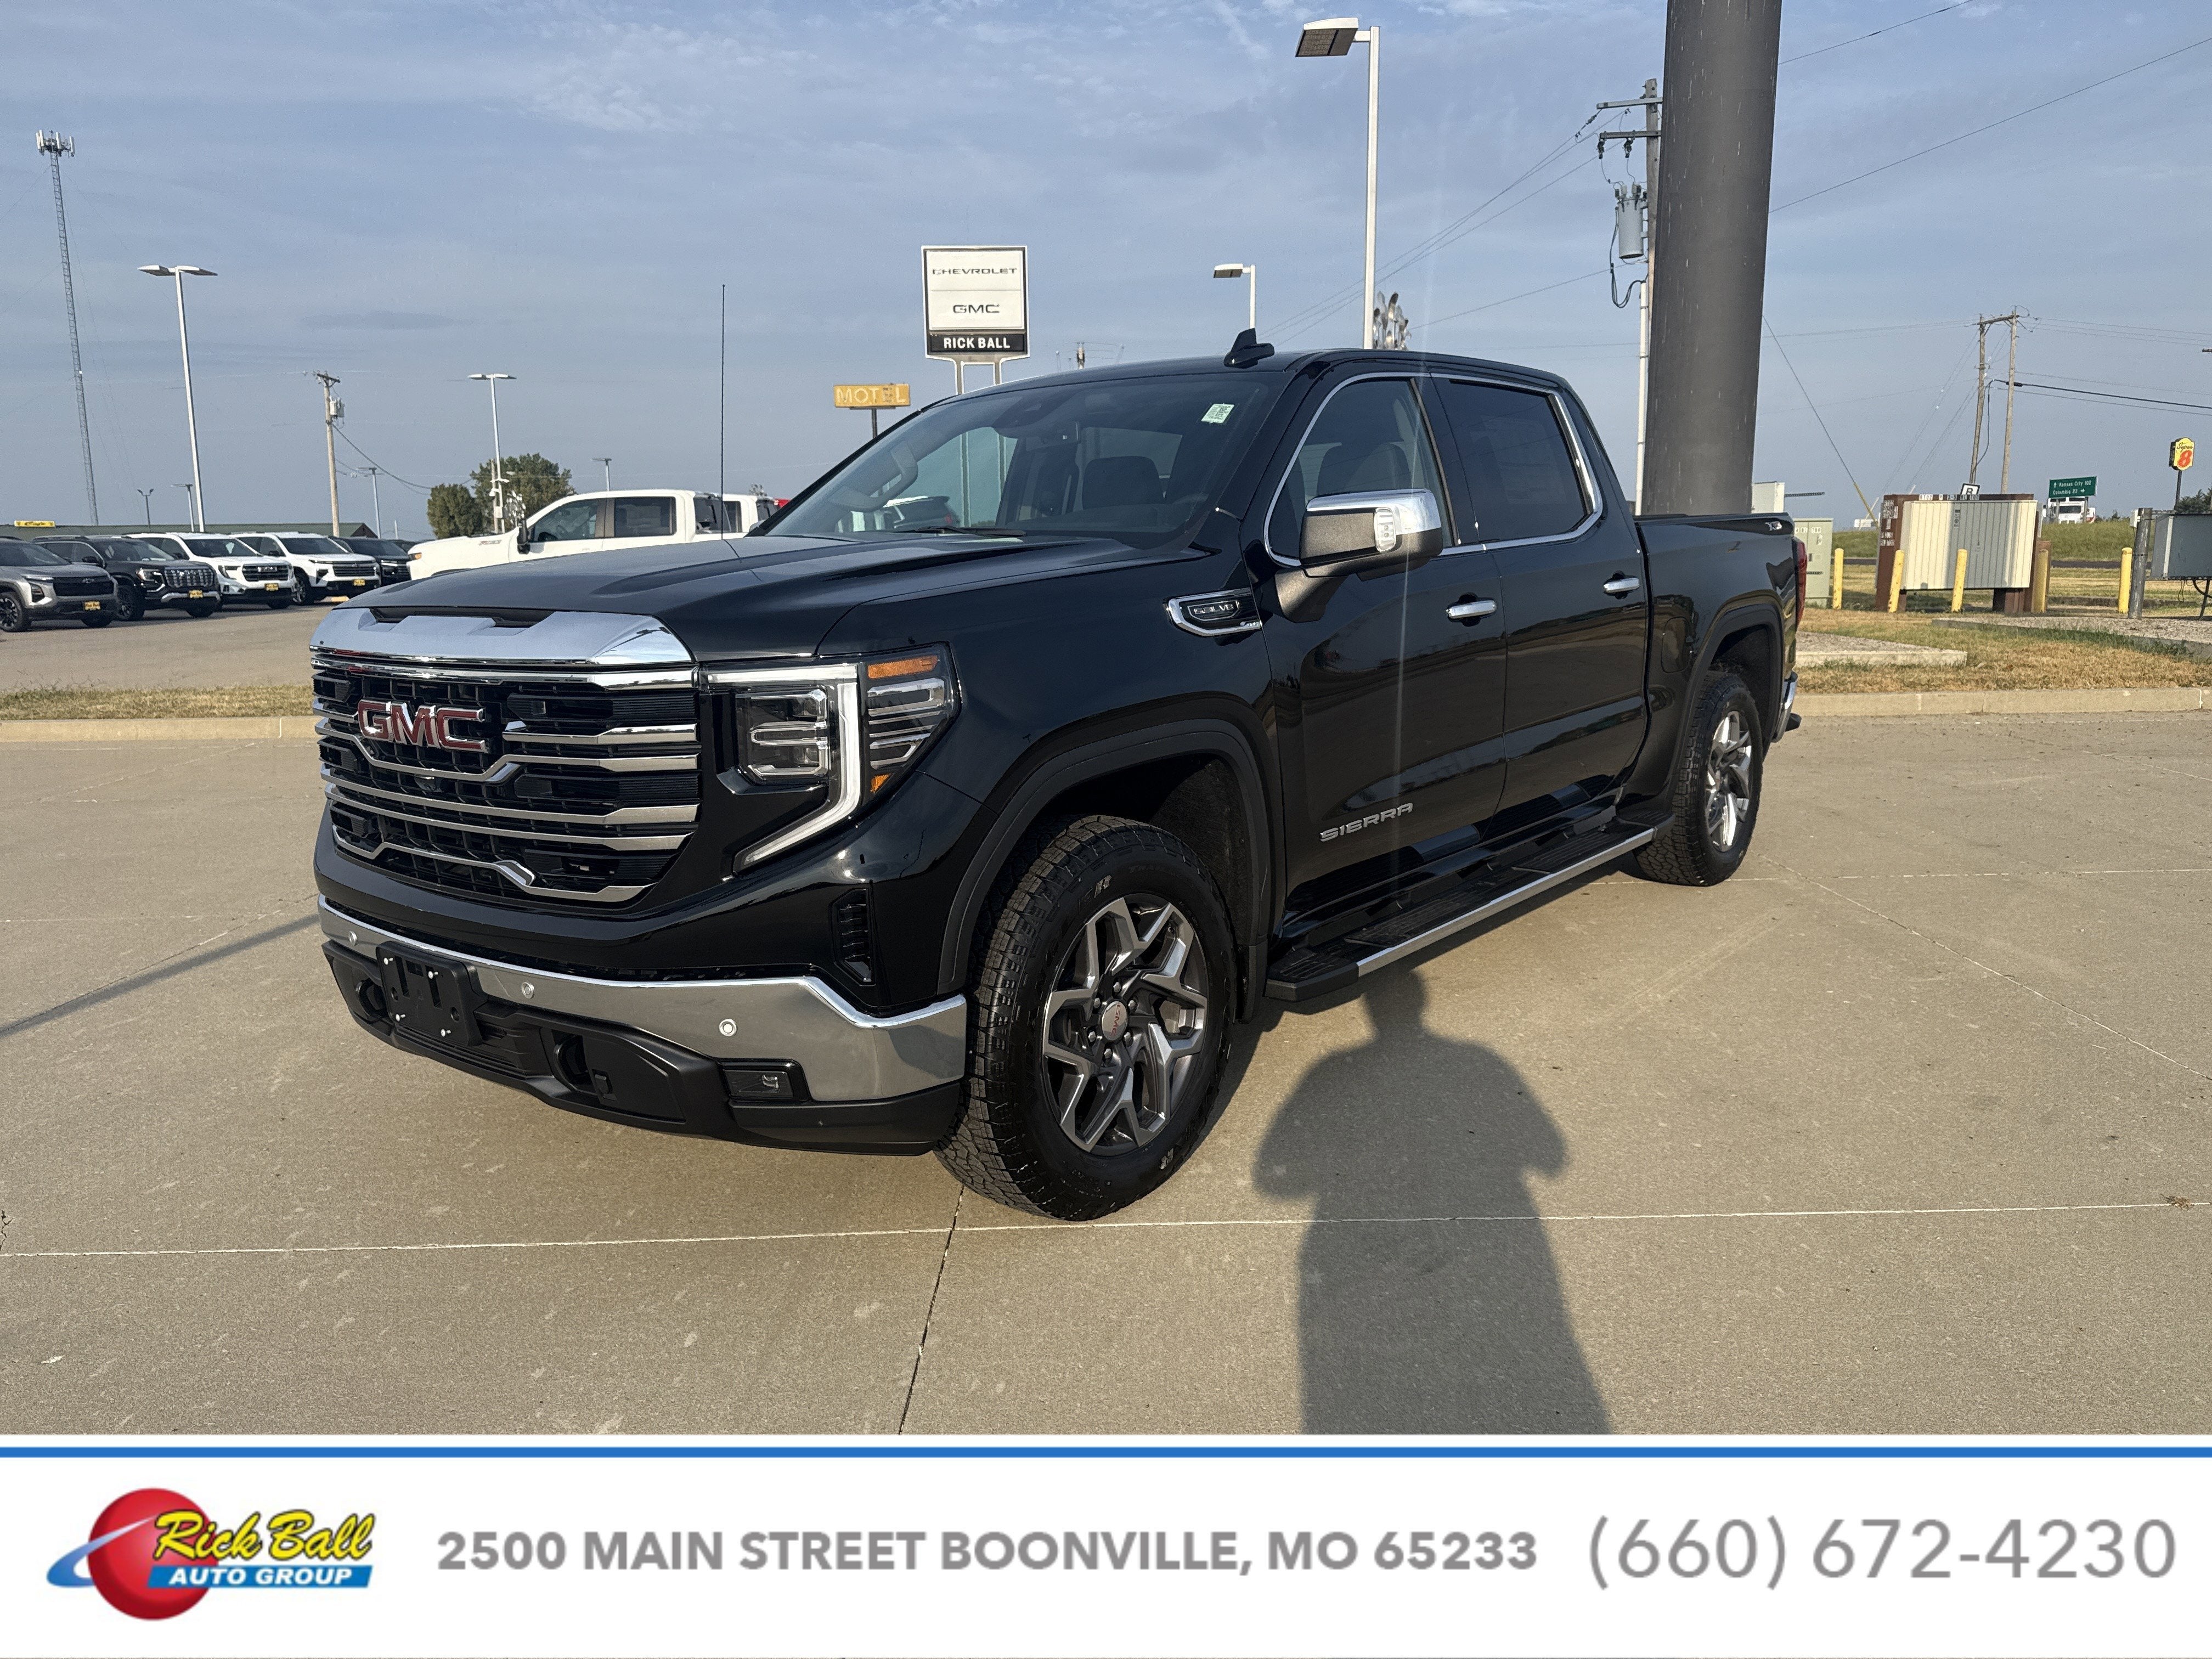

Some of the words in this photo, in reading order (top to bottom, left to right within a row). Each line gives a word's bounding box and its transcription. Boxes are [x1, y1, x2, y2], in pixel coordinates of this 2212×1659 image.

[953, 304, 1000, 314] GMC
[943, 337, 975, 349] RICK
[978, 337, 1011, 349] BALL
[836, 387, 906, 403] MOTEL
[2176, 442, 2193, 453] Super
[2177, 450, 2192, 467] 8
[358, 699, 490, 754] GMC
[1320, 802, 1413, 842] SIERRA
[1110, 1005, 1120, 1037] GMC
